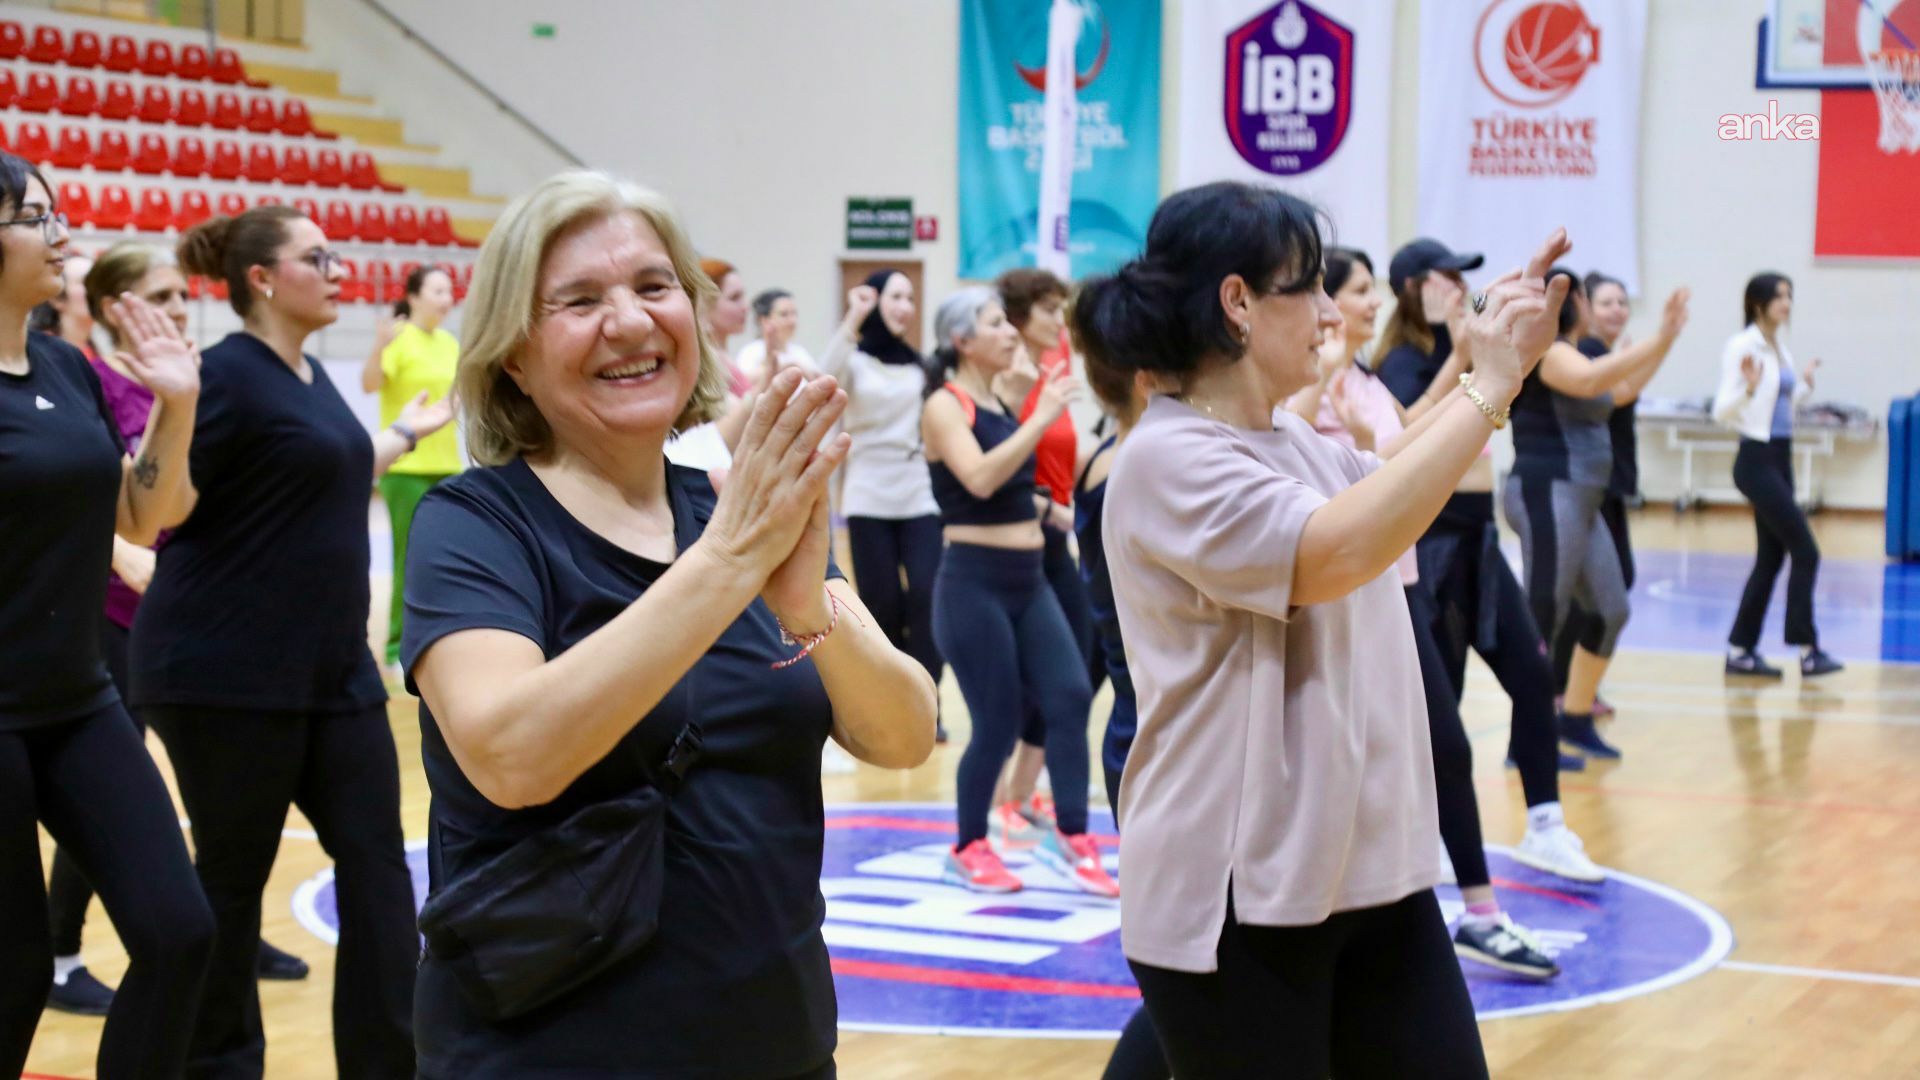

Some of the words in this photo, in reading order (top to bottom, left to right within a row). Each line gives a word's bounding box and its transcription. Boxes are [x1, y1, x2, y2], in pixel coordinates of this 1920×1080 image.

[1242, 40, 1335, 115] İBB
[1471, 112, 1597, 141] TÜRKİYE
[1469, 144, 1595, 160] BASKETBOL
